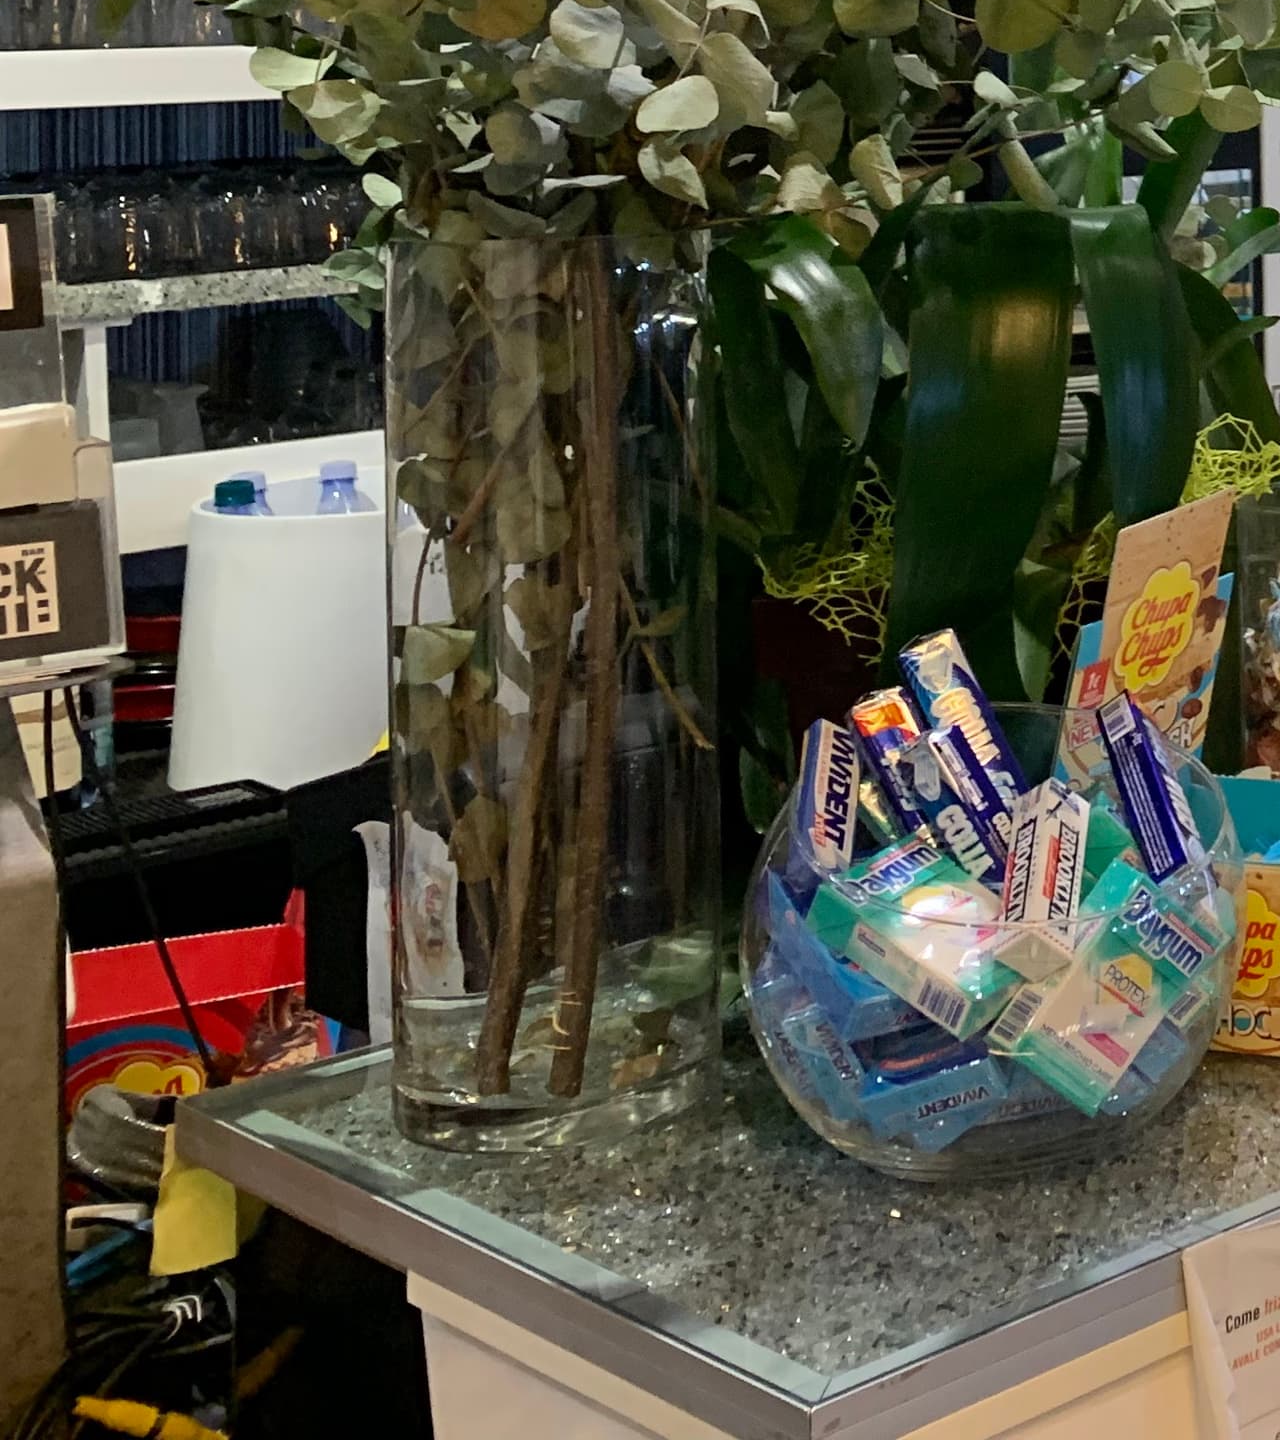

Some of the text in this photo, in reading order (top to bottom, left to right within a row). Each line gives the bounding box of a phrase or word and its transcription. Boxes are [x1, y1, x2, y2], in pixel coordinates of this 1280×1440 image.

[1131, 590, 1194, 634] Chupa
[1119, 620, 1185, 669] Chups
[822, 729, 855, 852] VIVIDENT
[1122, 884, 1203, 978] Daygum
[1103, 962, 1150, 1008] PROTEX
[1225, 1306, 1260, 1334] Come
